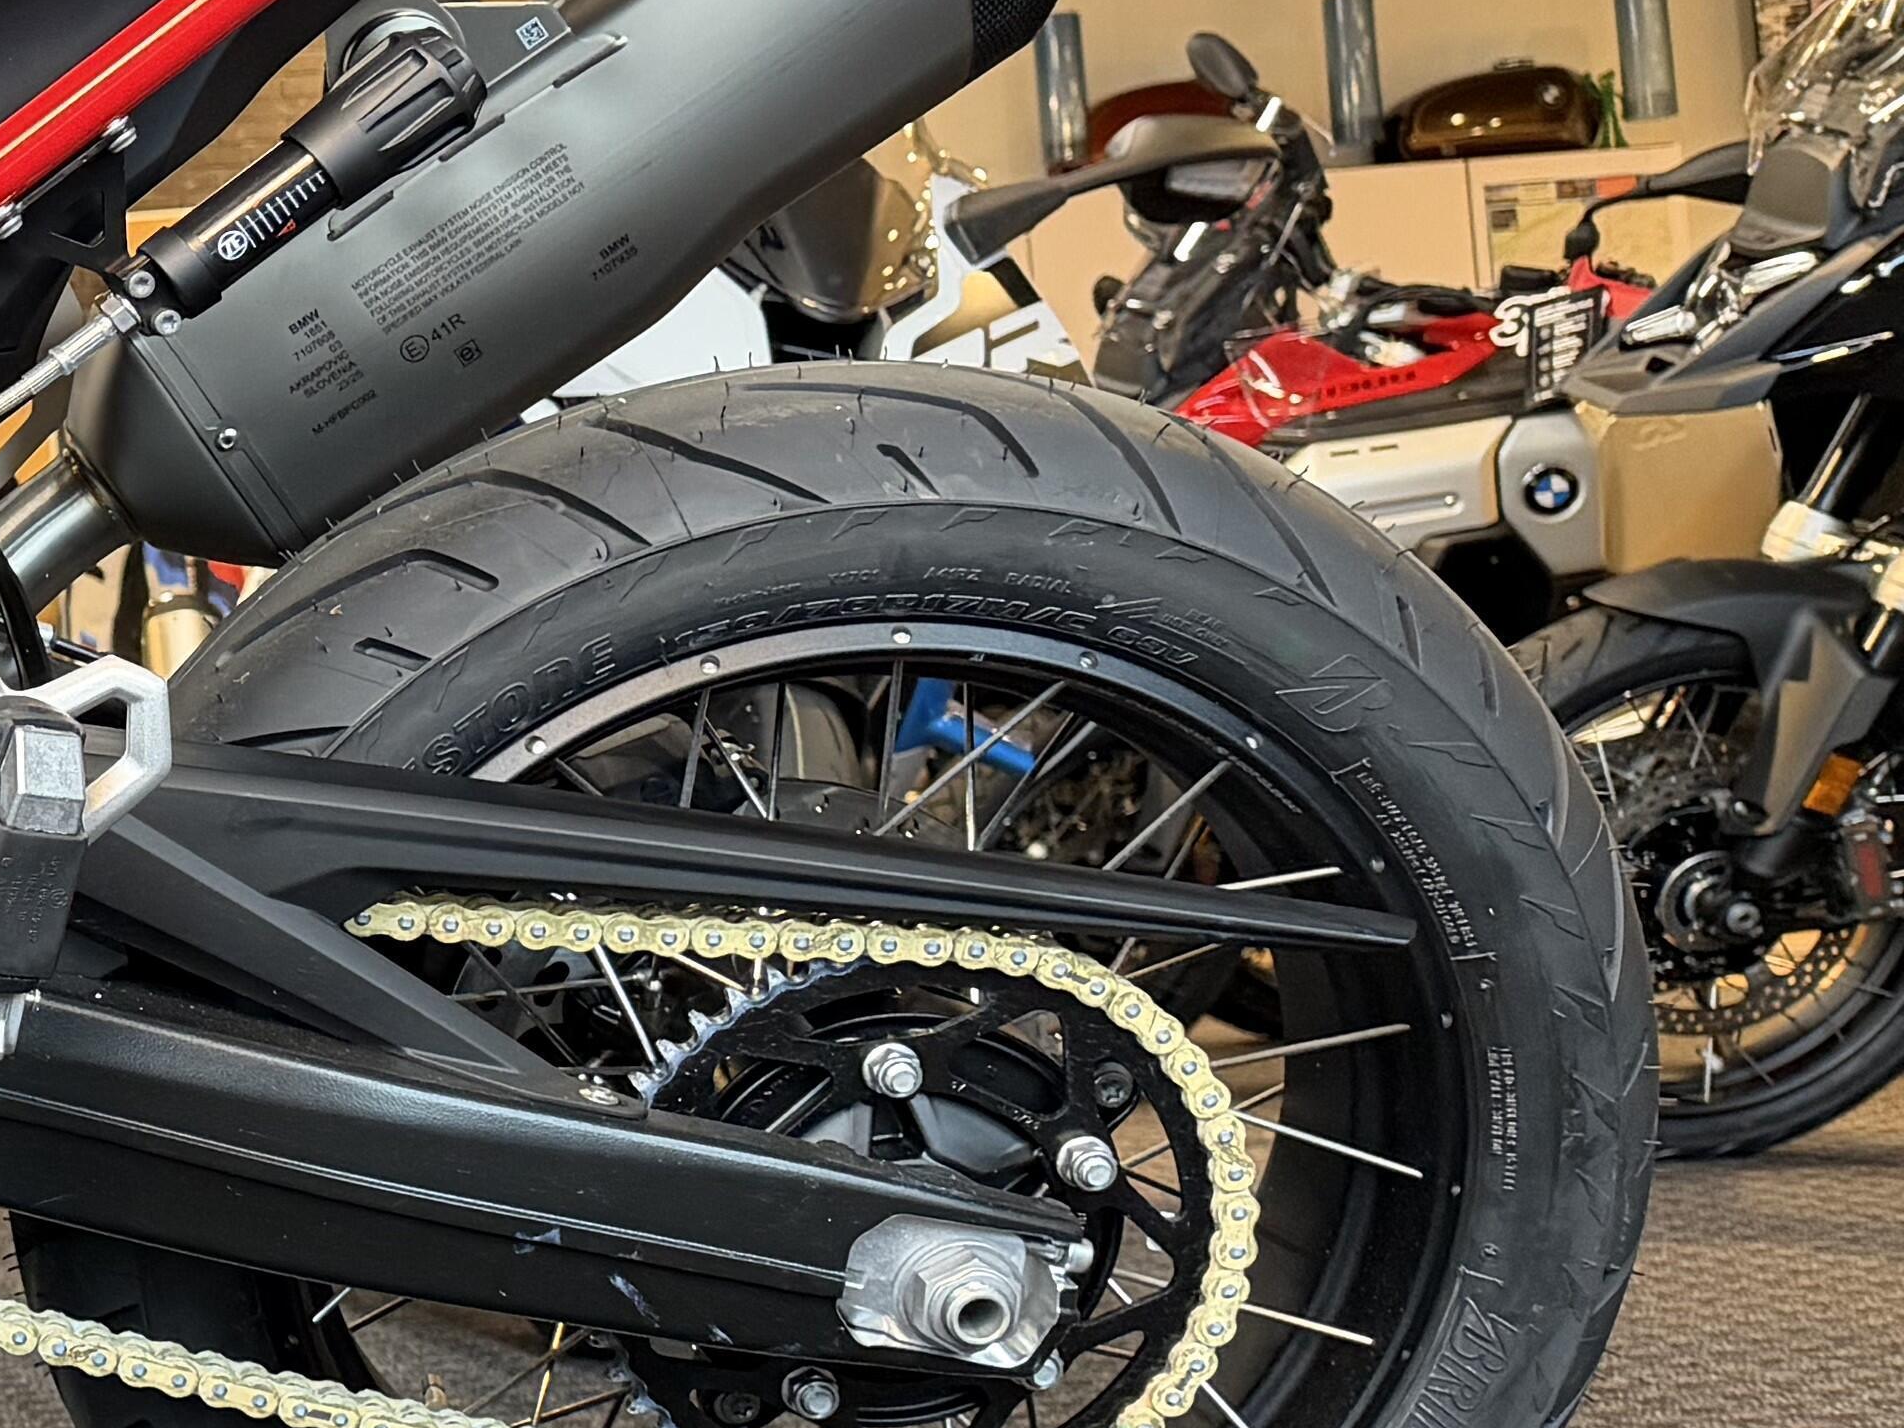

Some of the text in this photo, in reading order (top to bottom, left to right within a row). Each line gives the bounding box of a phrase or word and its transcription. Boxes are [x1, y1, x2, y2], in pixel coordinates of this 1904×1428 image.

[599, 233, 629, 260] BMW
[287, 308, 321, 335] BMW
[427, 311, 466, 344] 41R
